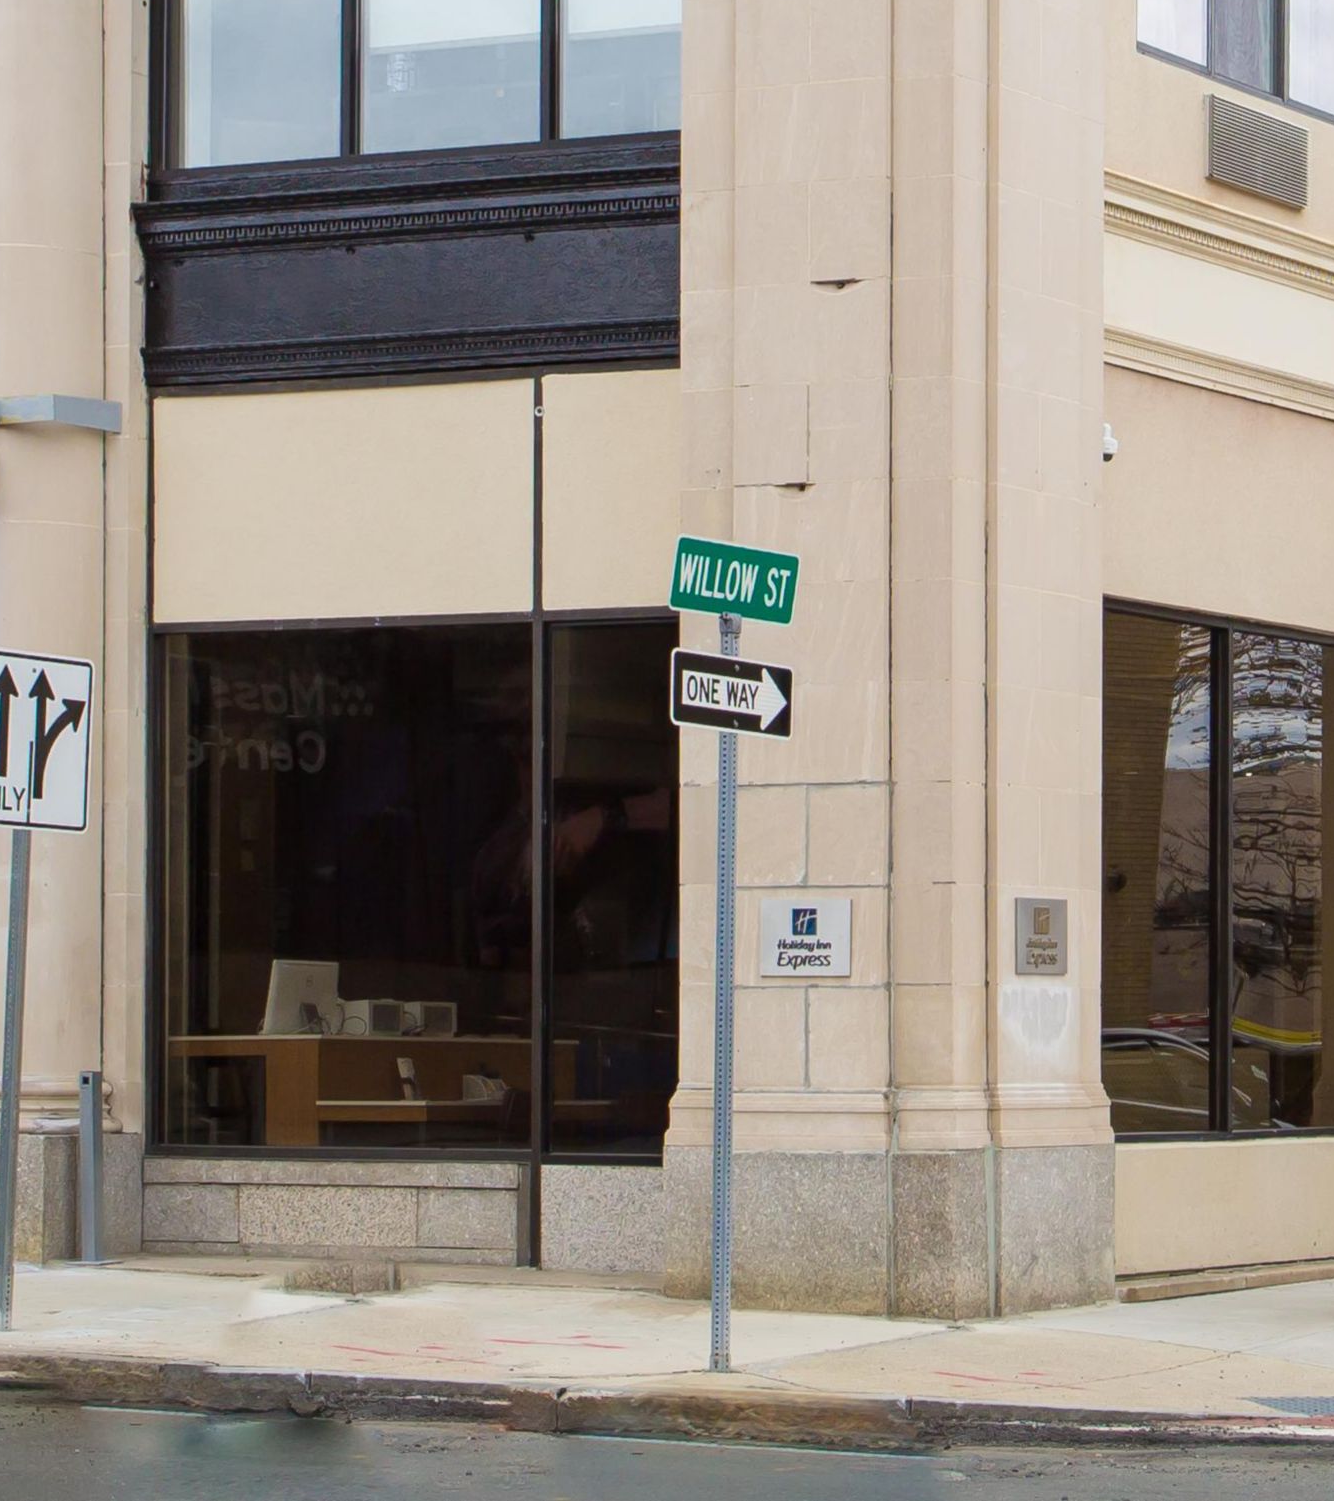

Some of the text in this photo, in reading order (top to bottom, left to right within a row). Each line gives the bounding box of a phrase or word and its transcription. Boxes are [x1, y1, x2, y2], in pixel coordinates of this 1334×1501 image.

[679, 552, 791, 609] WILLOW ST
[686, 674, 759, 710] ONE WAY
[777, 938, 832, 952] Holiday Inn
[777, 951, 832, 971] Express
